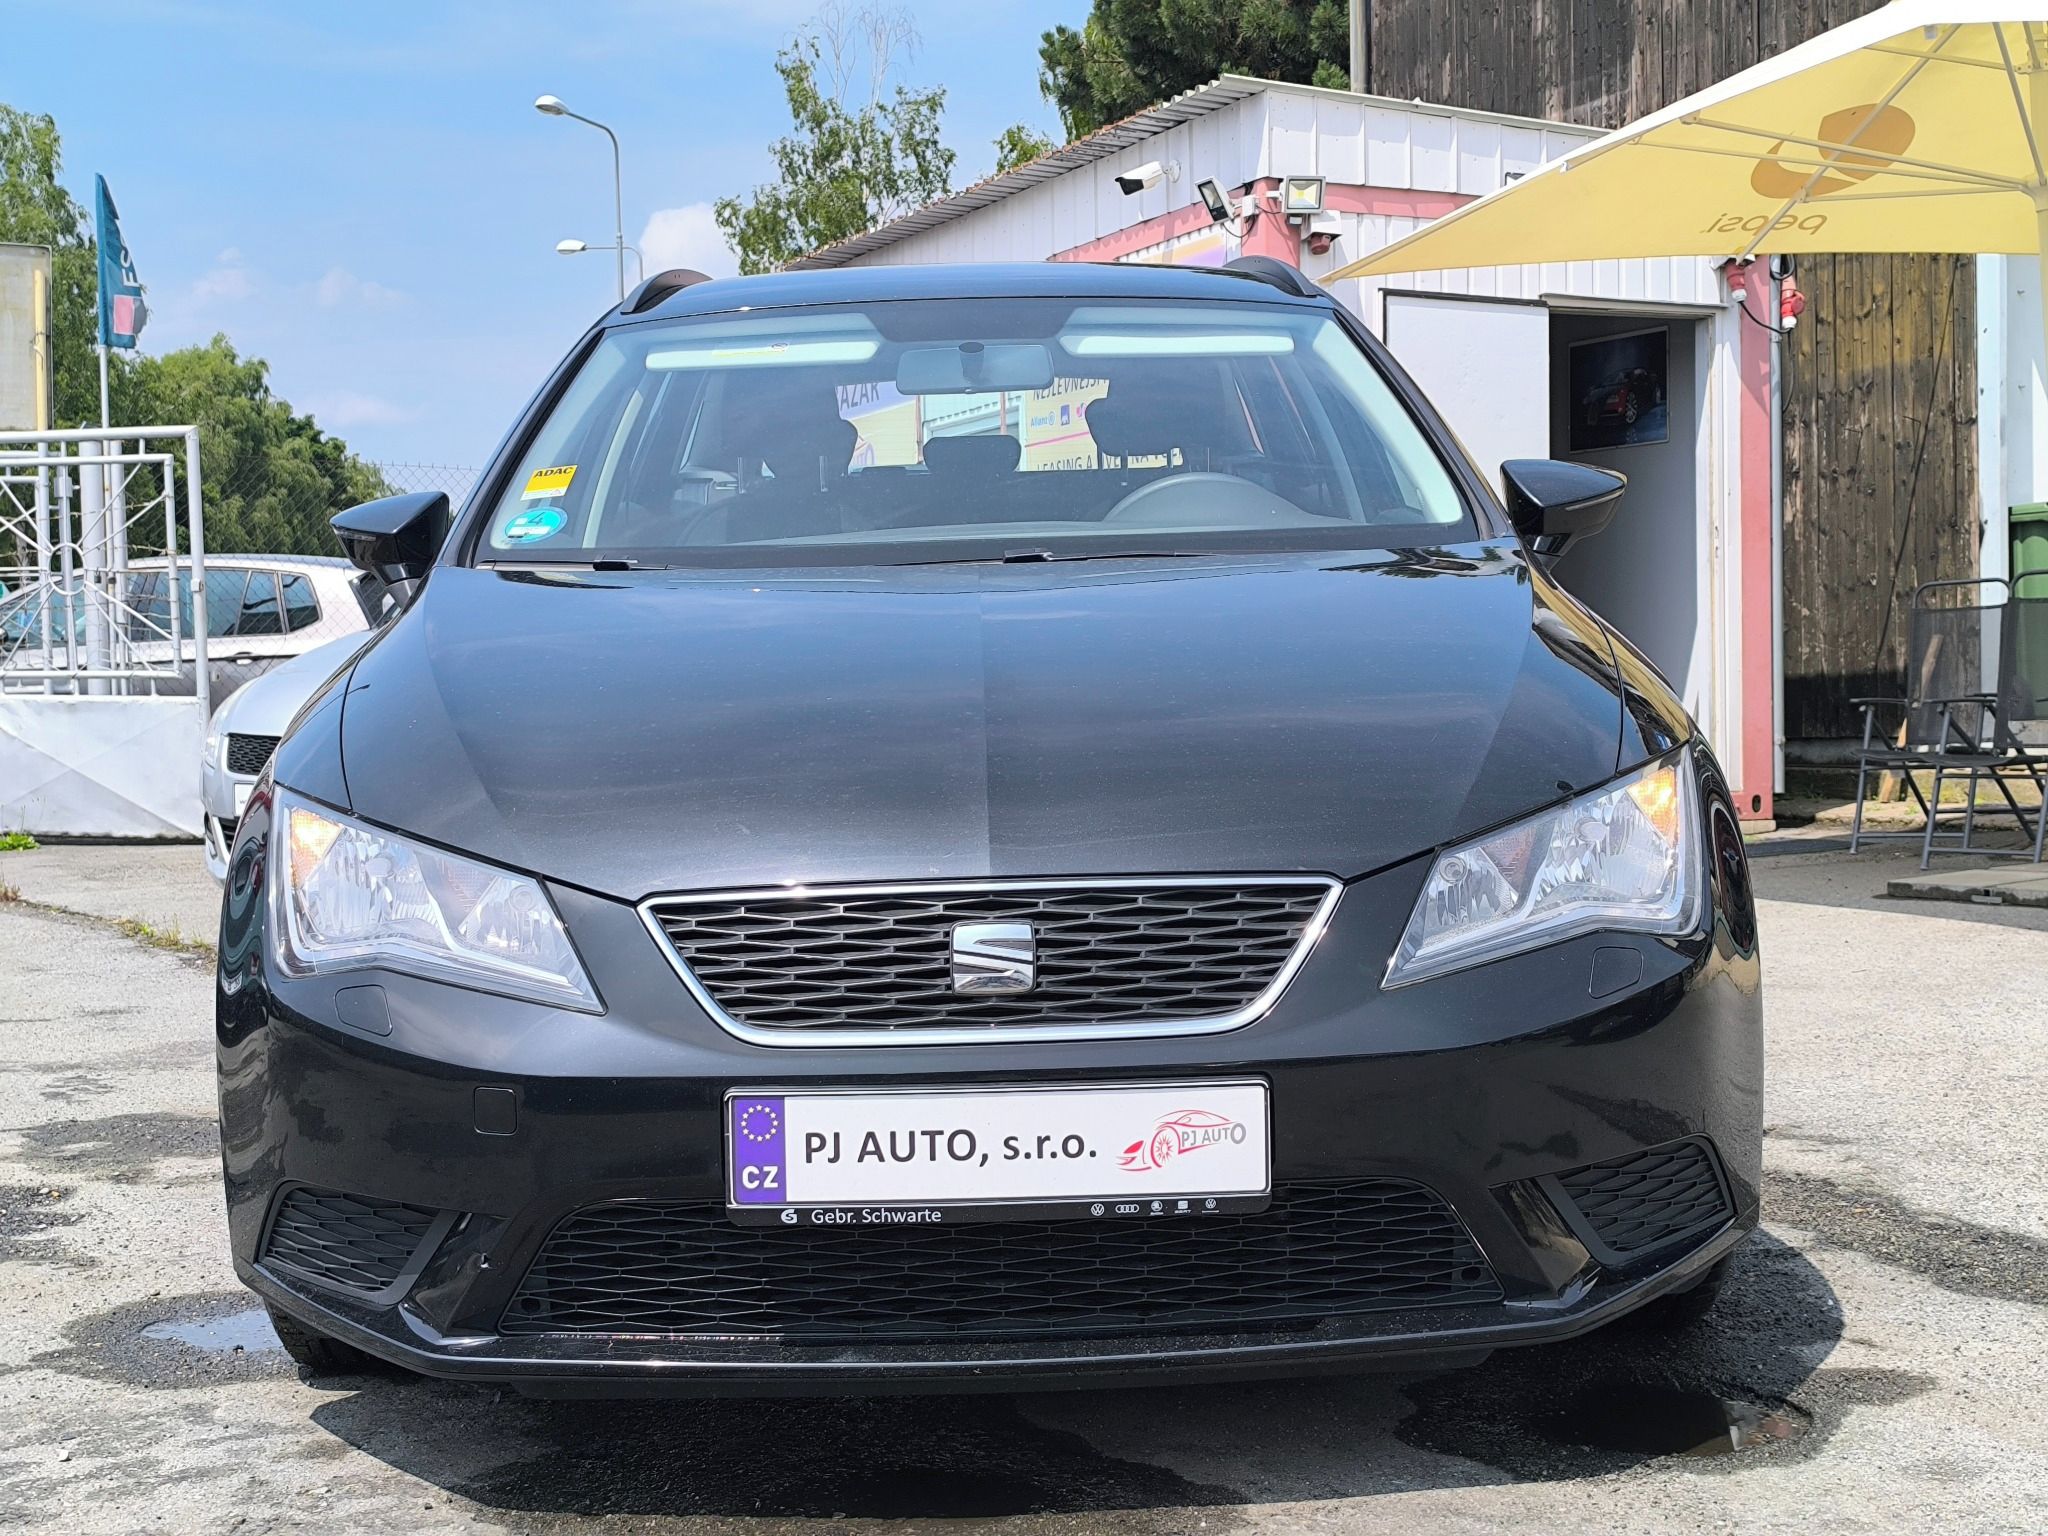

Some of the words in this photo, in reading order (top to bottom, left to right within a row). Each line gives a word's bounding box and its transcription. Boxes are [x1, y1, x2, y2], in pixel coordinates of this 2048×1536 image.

[534, 467, 574, 478] ADAC
[1181, 1130, 1197, 1147] PJ
[1201, 1122, 1247, 1145] AUTO
[805, 1132, 841, 1163] PJ
[857, 1129, 989, 1167] AUTO,
[1003, 1134, 1097, 1160] s.r.o.
[742, 1165, 779, 1189] CZ
[811, 1209, 857, 1224] Gebr.
[862, 1207, 942, 1223] Schwarte
